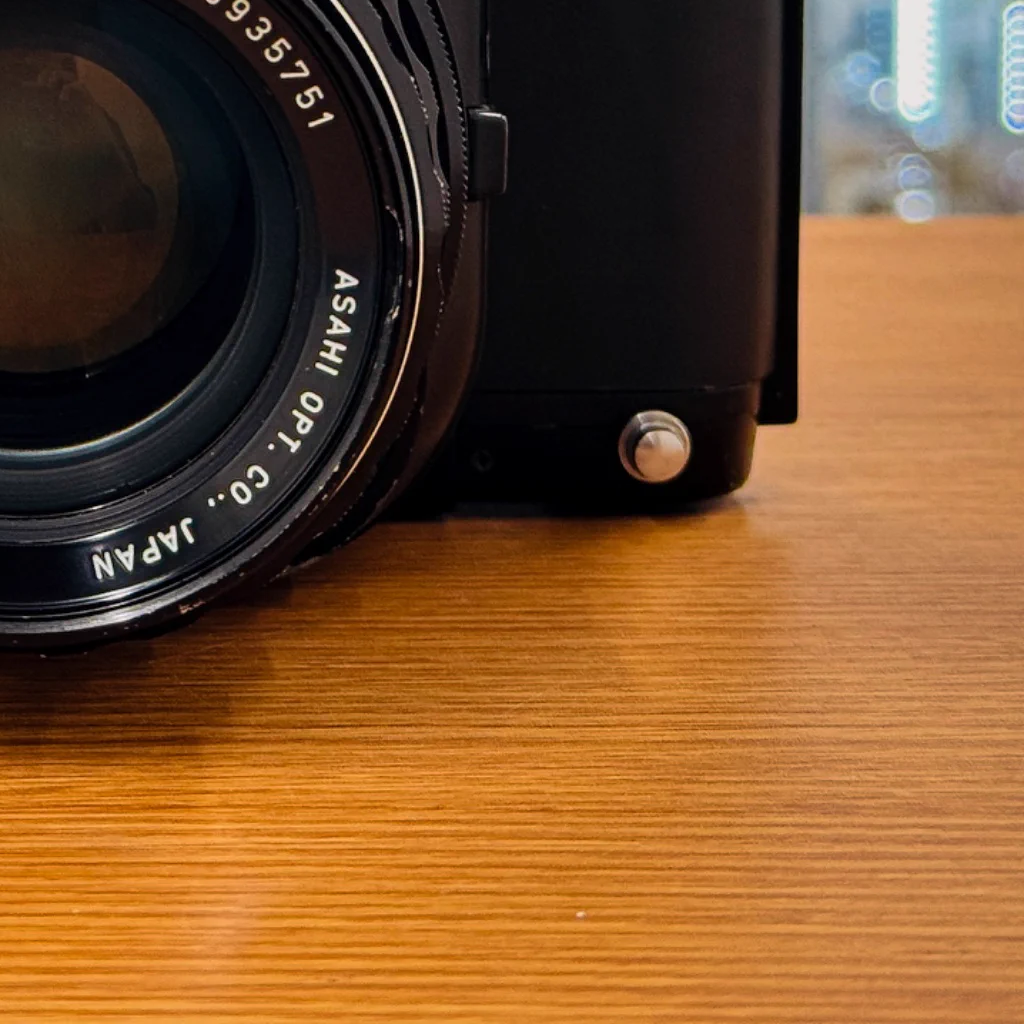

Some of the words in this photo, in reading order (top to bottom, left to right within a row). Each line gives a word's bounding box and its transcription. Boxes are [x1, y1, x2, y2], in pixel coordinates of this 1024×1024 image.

[314, 268, 360, 377] ASAHI
[266, 390, 325, 455] OPT.
[91, 516, 196, 582] JAPAN
